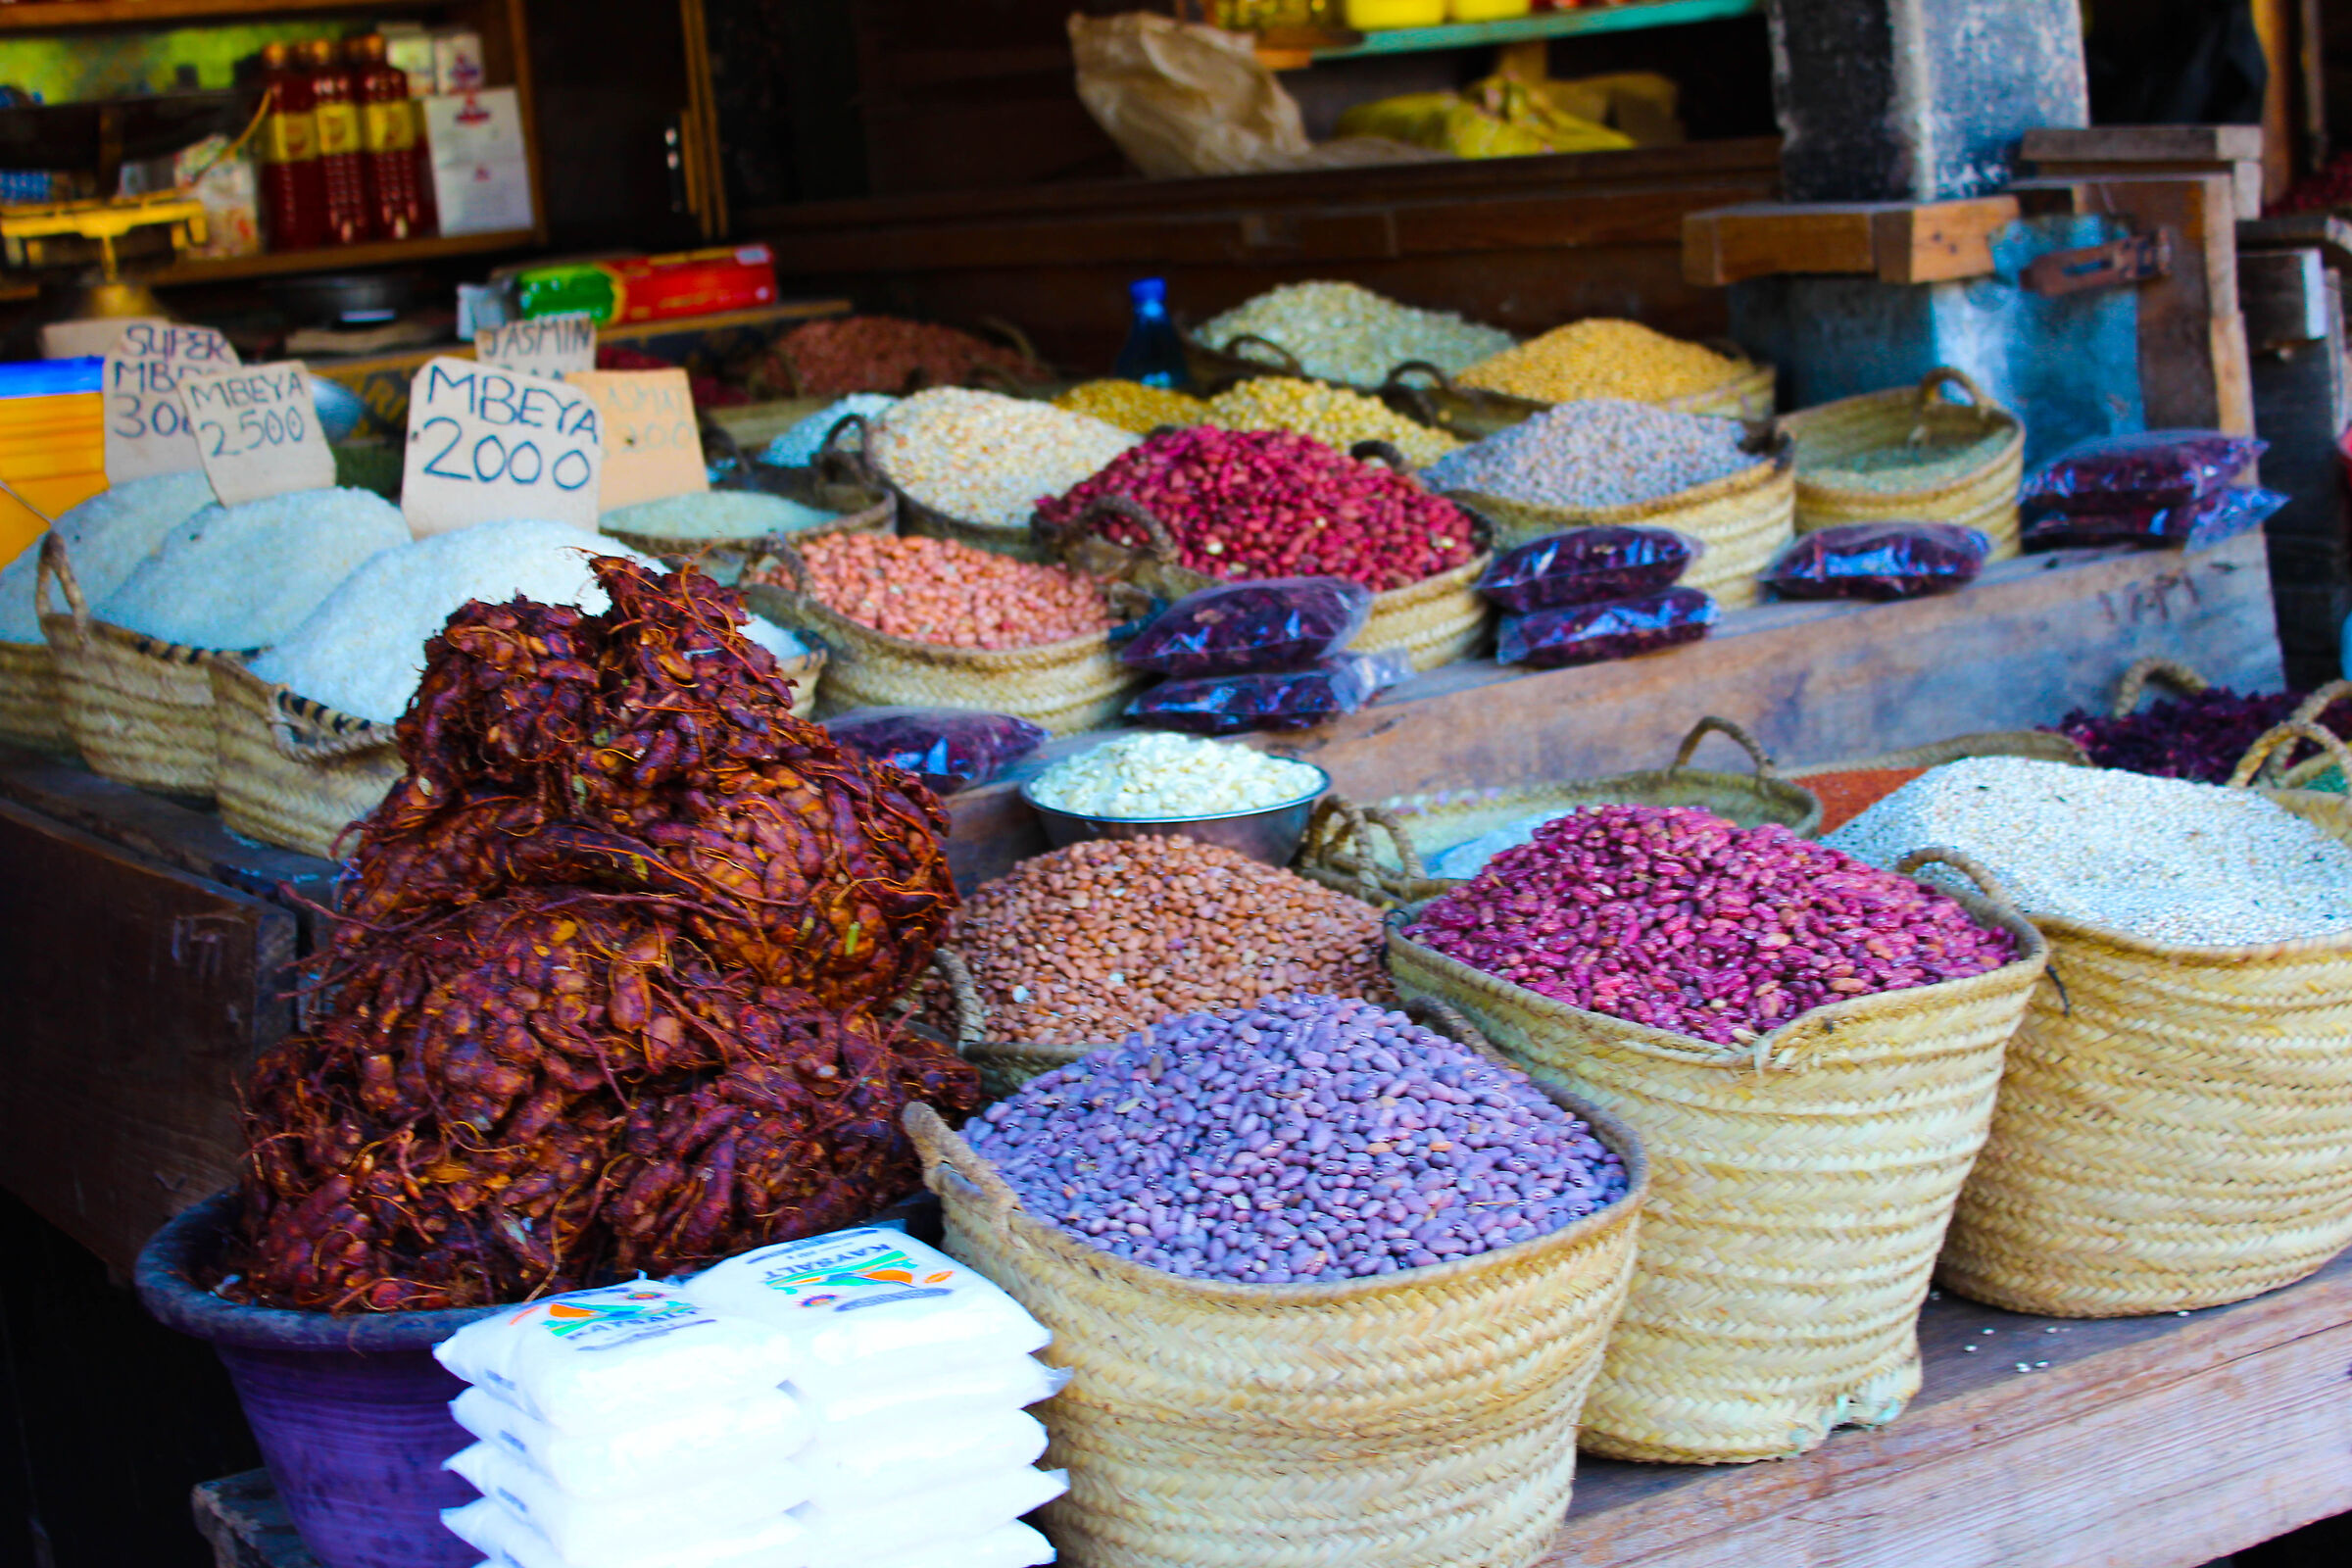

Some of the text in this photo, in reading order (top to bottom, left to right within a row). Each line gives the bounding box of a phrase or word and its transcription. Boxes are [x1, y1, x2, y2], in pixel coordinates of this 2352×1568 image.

[123, 323, 233, 364] SUPER
[189, 371, 305, 411] MBEYA
[427, 365, 599, 445] MBEYA
[199, 405, 306, 458] 2500
[422, 416, 591, 491] 2000
